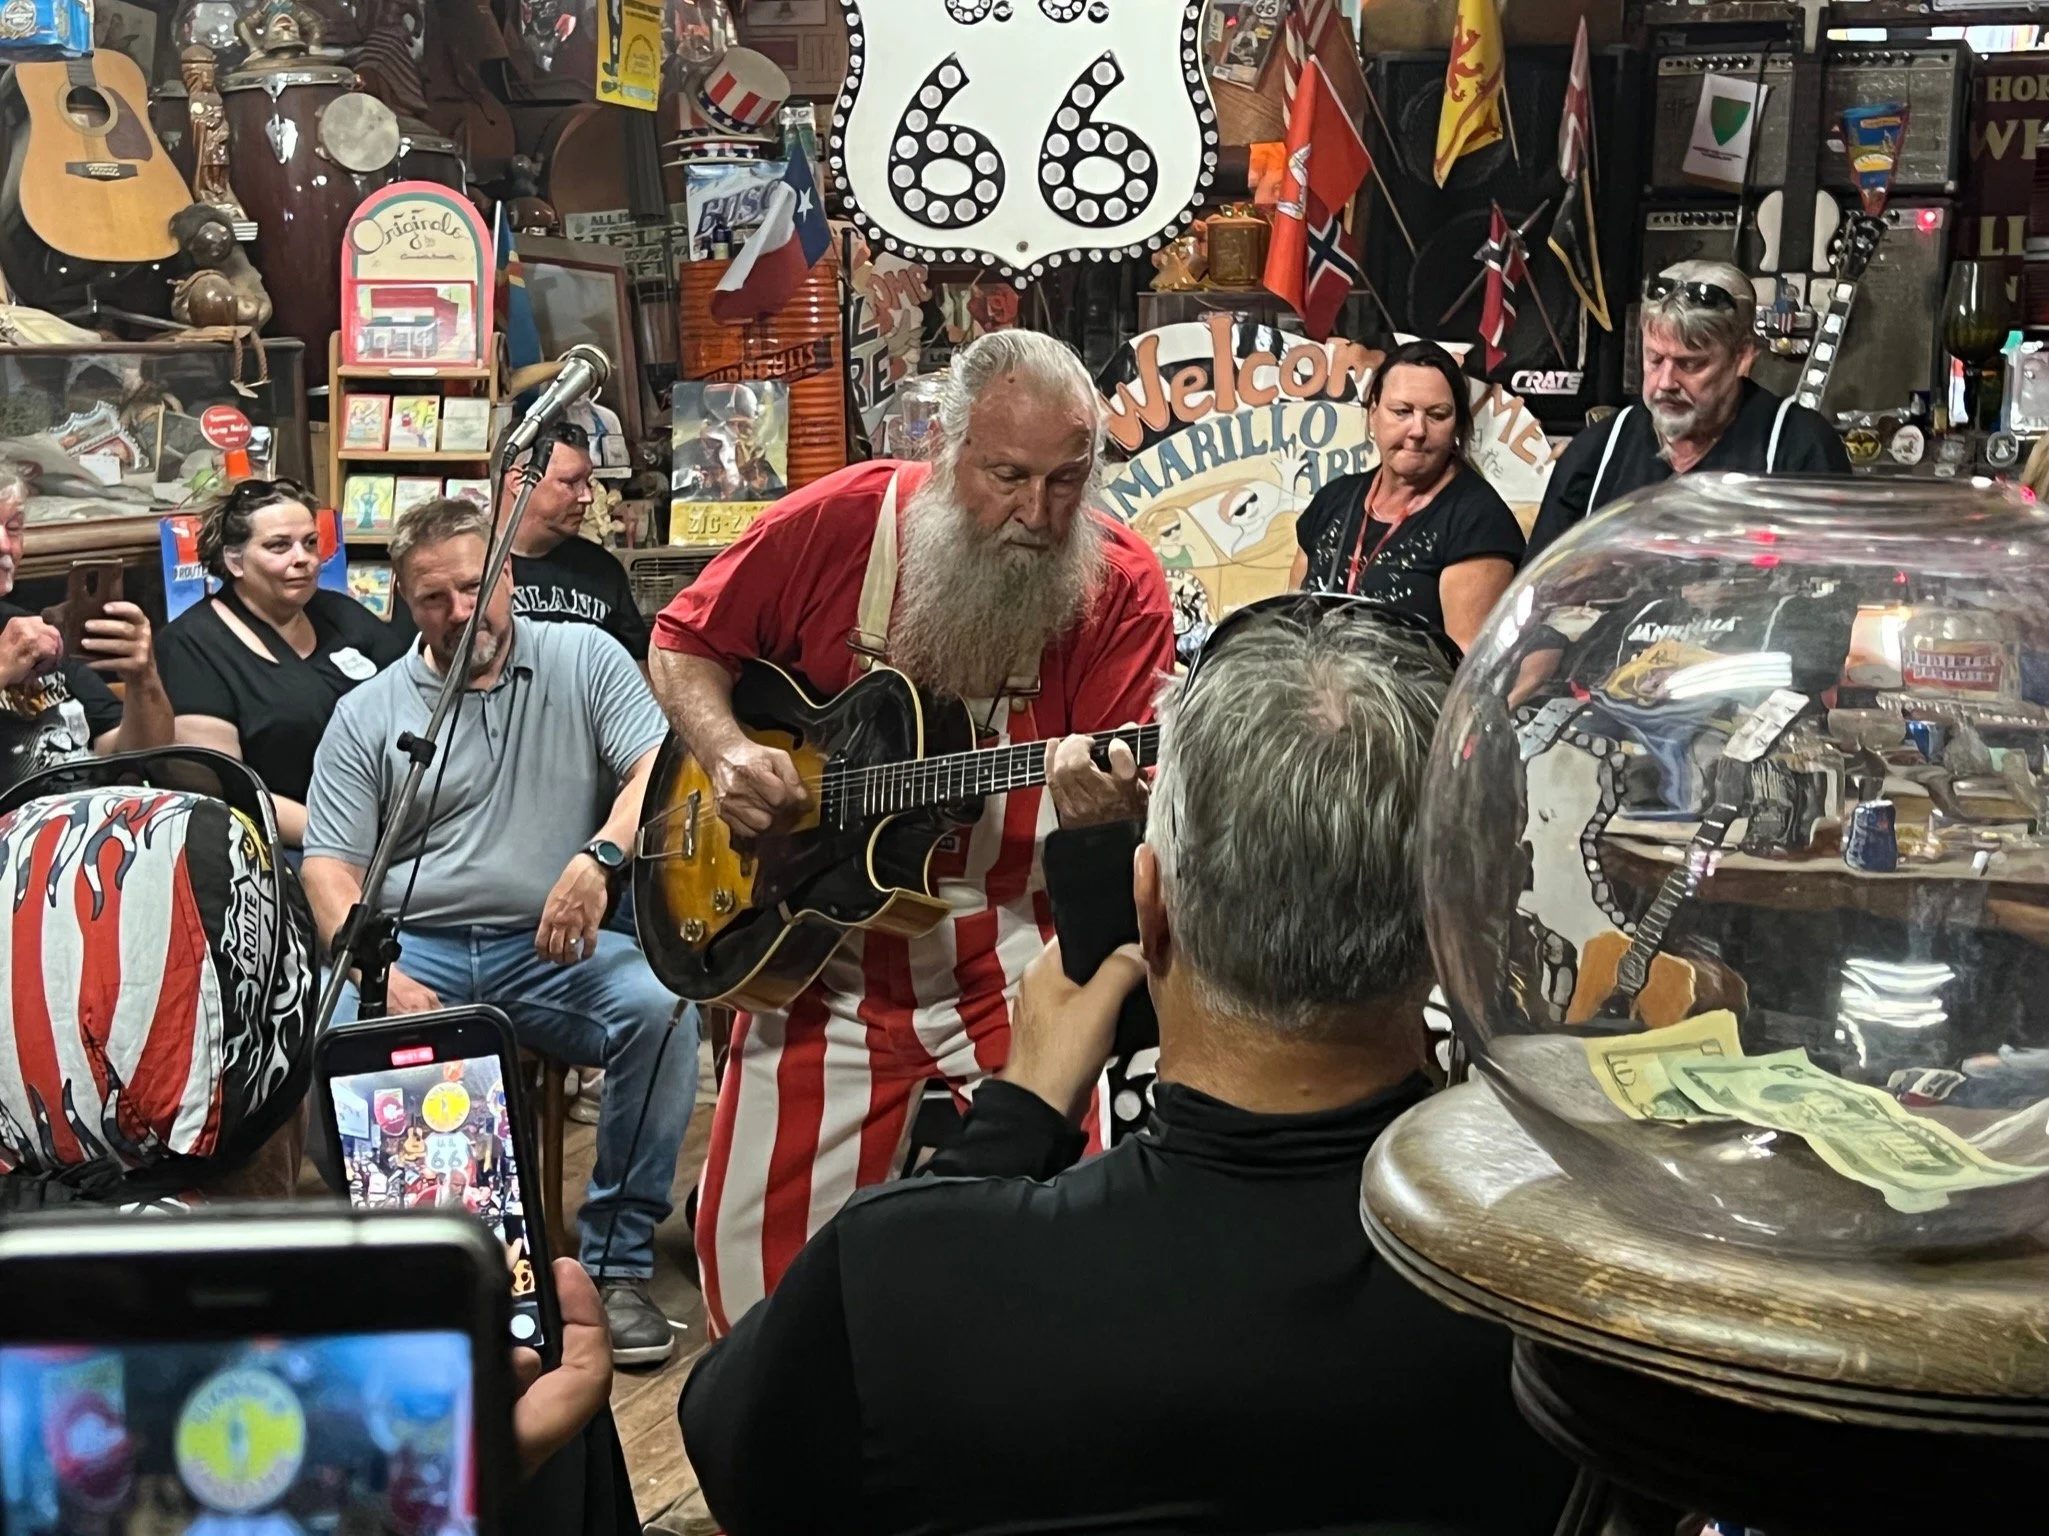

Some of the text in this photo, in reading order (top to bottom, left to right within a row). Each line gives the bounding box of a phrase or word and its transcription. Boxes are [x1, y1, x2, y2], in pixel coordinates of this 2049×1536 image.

[888, 50, 1158, 229] 66
[1091, 315, 1387, 450] Welcom
[1511, 370, 1584, 395] CRATE
[243, 892, 258, 965] ROUTE
[431, 1151, 463, 1170] 66
